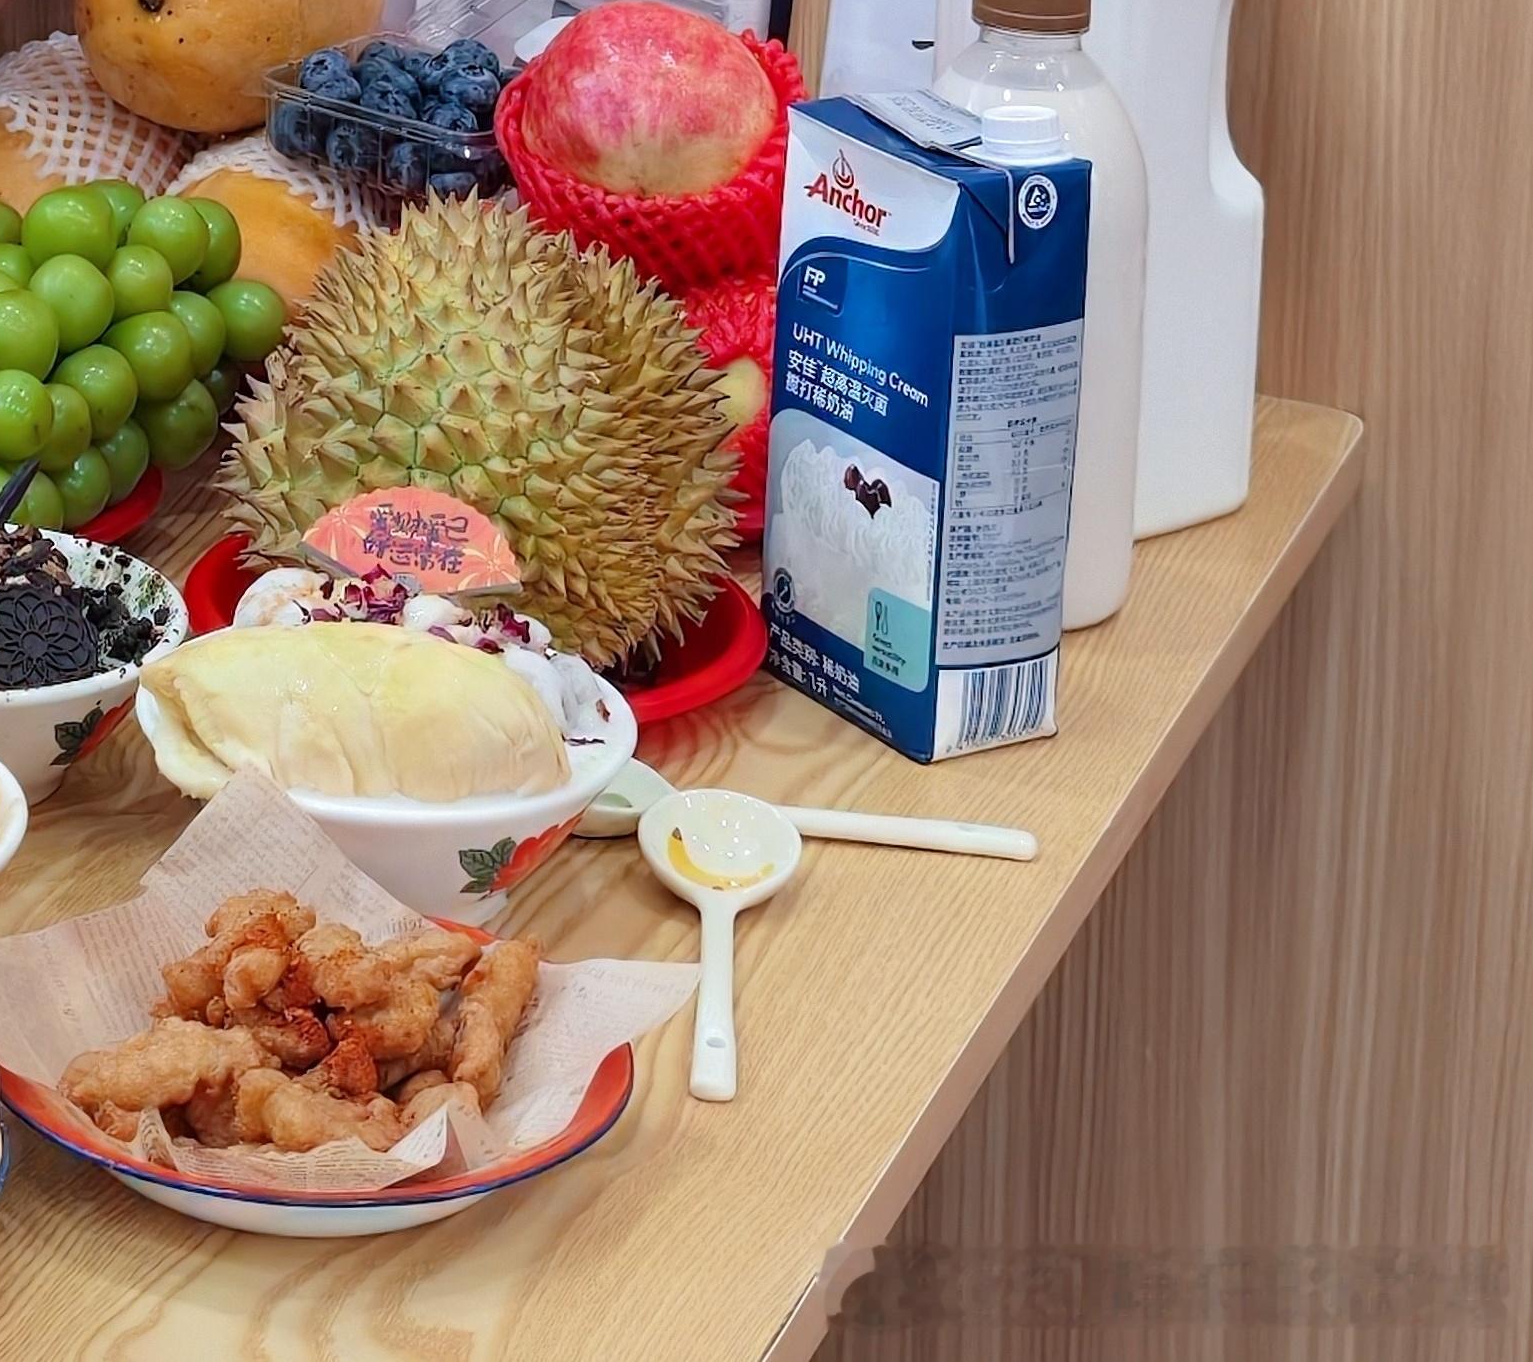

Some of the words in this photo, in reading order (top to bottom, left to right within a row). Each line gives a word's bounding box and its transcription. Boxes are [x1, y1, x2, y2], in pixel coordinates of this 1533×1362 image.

[803, 171, 888, 228] Anchor
[792, 322, 824, 350] UHT
[826, 337, 887, 386] Whipping
[888, 372, 929, 408] Cream
